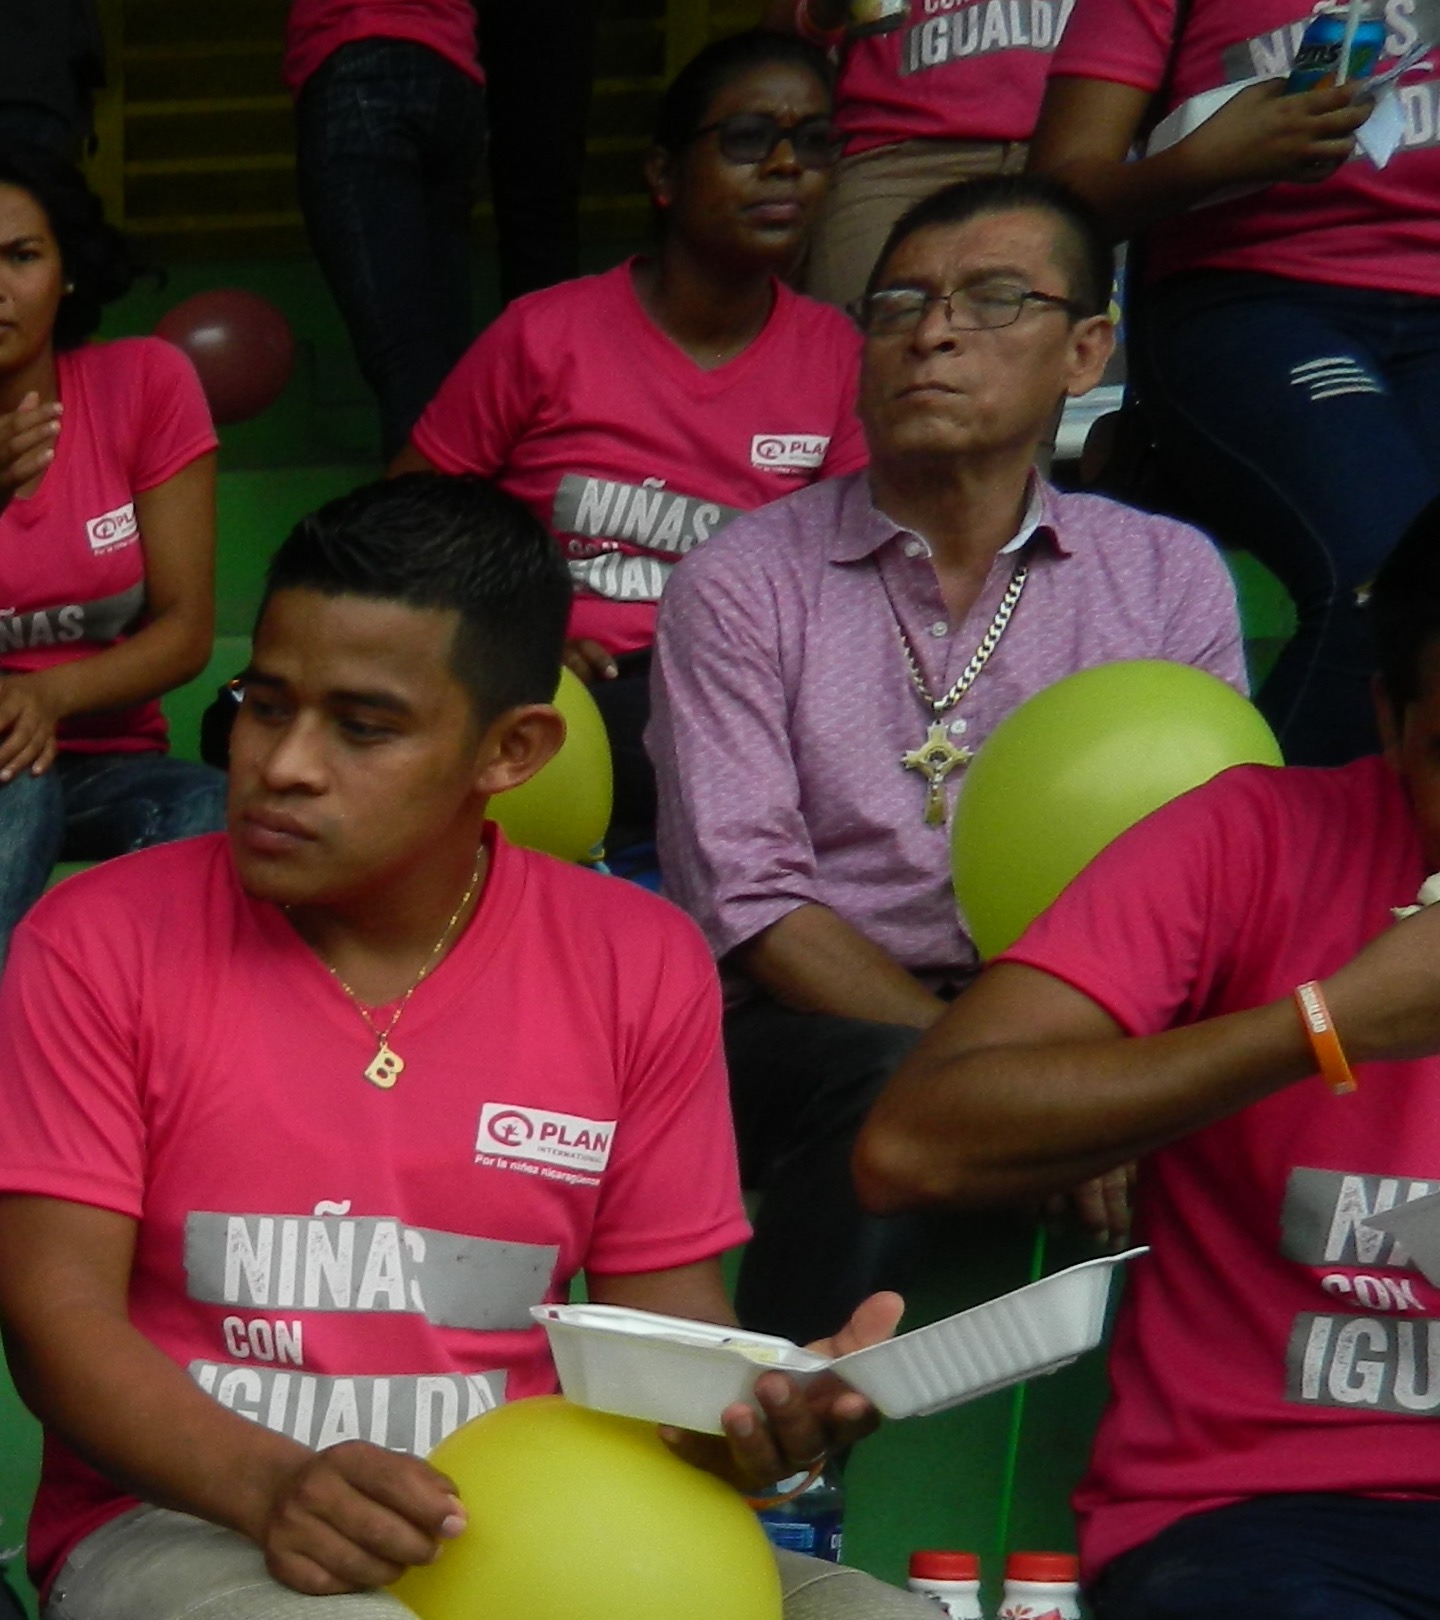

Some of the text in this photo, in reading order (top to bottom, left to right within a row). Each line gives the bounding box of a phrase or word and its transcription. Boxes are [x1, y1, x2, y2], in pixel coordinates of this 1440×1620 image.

[574, 477, 721, 553] NIÑAS
[540, 1122, 609, 1153] PLAN
[474, 1153, 494, 1165] Por
[496, 1158, 508, 1169] la
[223, 1316, 304, 1367] CON
